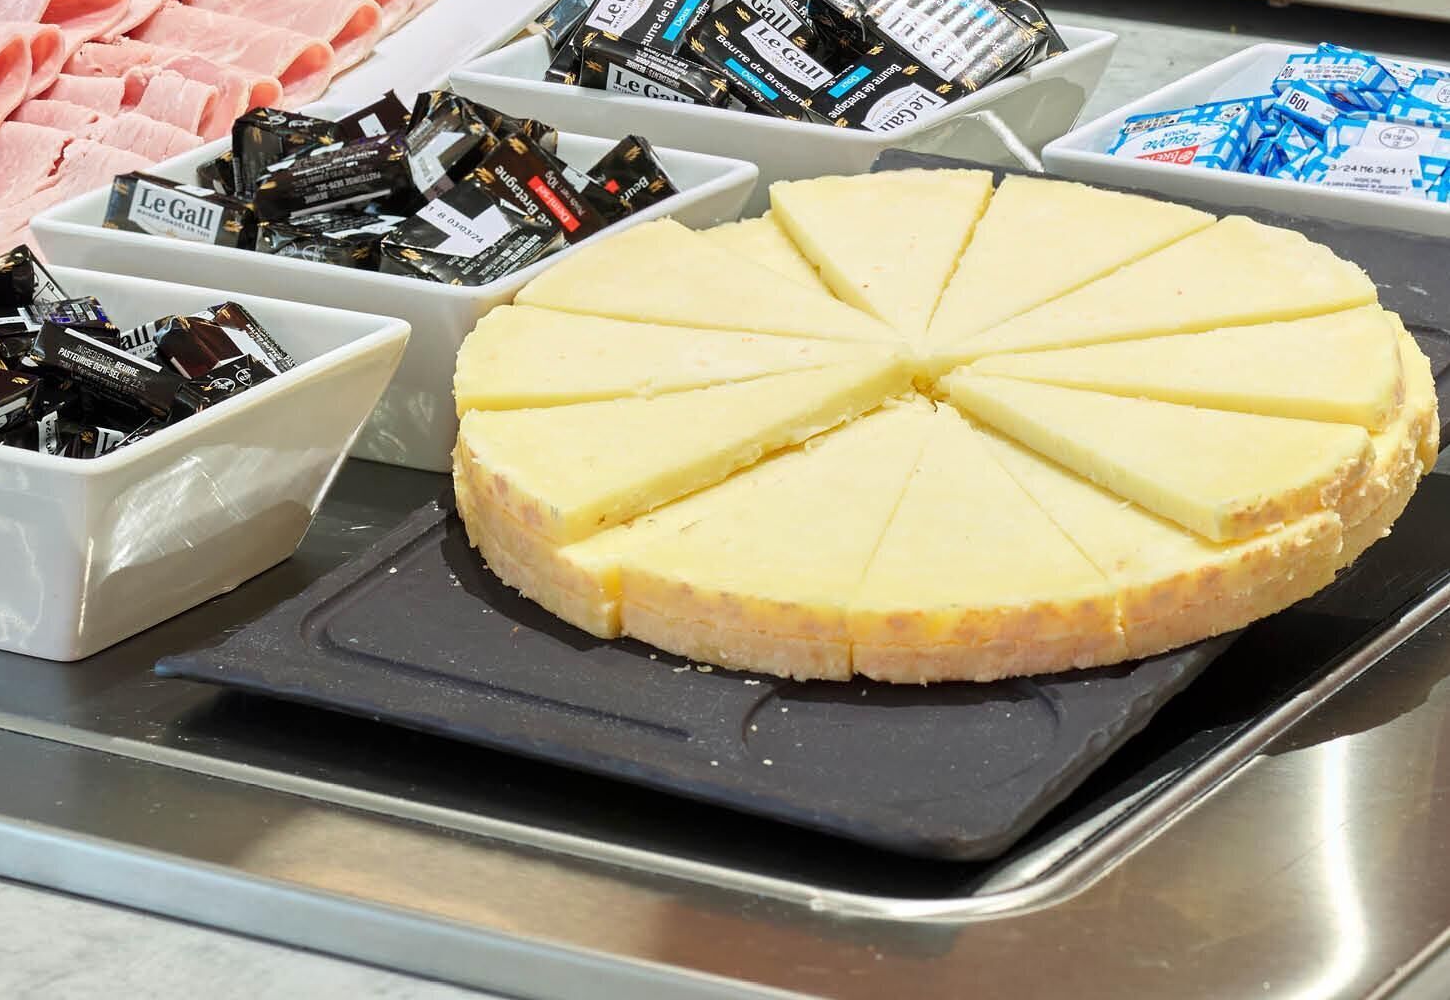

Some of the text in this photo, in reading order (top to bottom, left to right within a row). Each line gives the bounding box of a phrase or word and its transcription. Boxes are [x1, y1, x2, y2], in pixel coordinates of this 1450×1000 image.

[597, 1, 621, 27] Le
[656, 8, 669, 22] de
[675, 6, 691, 27] Doux
[756, 26, 782, 49] Le
[780, 46, 824, 81] Gall
[613, 71, 641, 91] Le
[715, 34, 751, 63] Beurre
[750, 61, 765, 74] de
[763, 73, 806, 107] Bretagn
[741, 70, 763, 88] Doux
[841, 74, 859, 89] Doux
[872, 62, 901, 87] Beurre
[863, 82, 875, 95] de
[827, 89, 864, 120] Bretagne
[911, 91, 935, 115] Le
[1289, 93, 1310, 112] 10g
[544, 170, 561, 188] 10g
[1376, 166, 1396, 174] 364
[494, 163, 539, 217] Bretagne
[620, 177, 649, 203] Beur
[139, 189, 215, 229] Le Gall
[536, 183, 570, 224] Demi-sel
[448, 217, 483, 244] 03/03/24
[120, 324, 149, 350] all
[57, 348, 94, 368] PASTEURISE
[92, 364, 121, 379] DEMI-SEL
[114, 362, 139, 376] BEURRE
